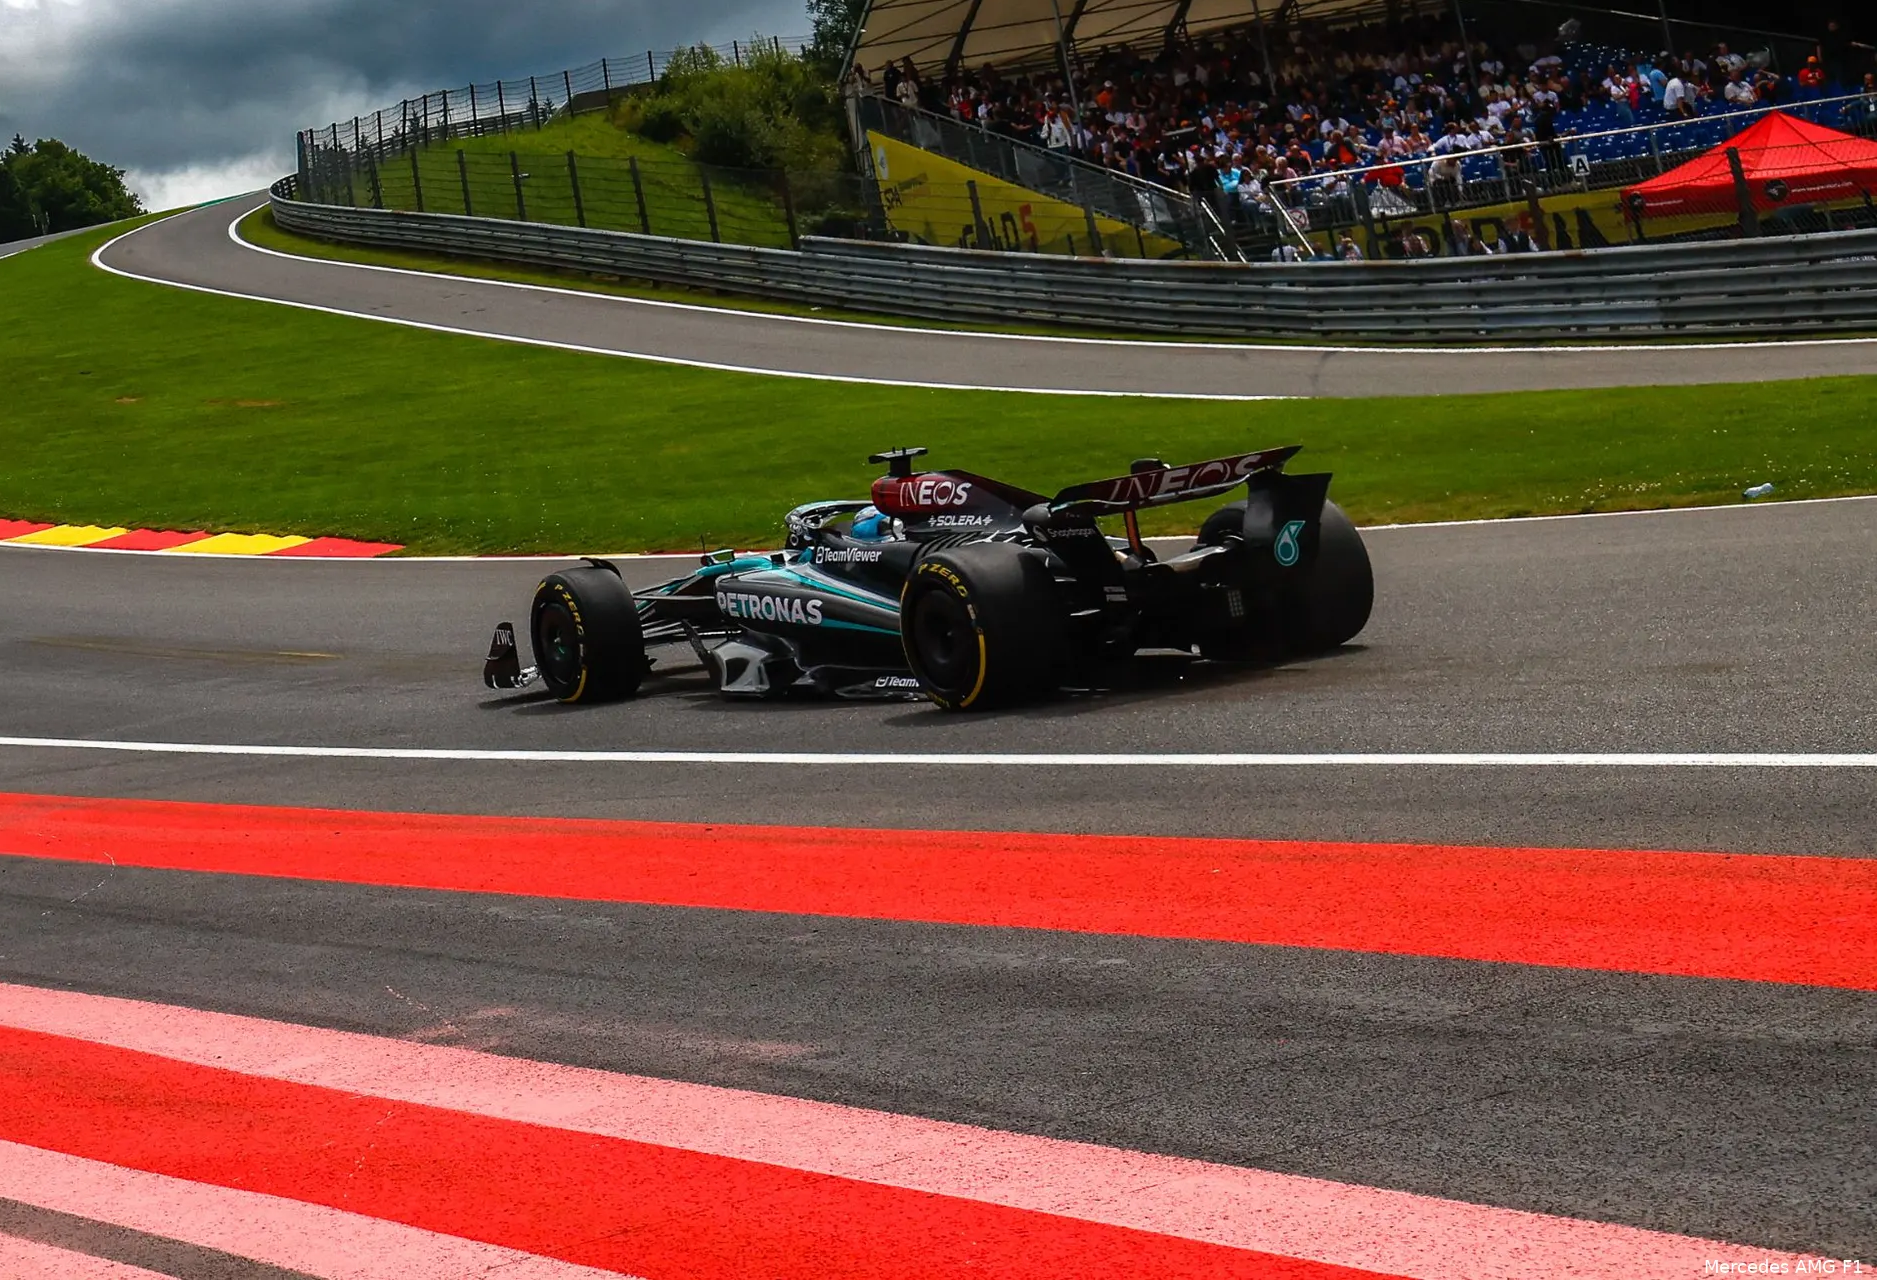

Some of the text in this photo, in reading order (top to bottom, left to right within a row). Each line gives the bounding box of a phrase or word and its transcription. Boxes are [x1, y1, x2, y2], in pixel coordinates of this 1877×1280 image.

[1576, 158, 1589, 173] A
[1105, 455, 1262, 508] INEOS
[900, 480, 972, 506] INEOS
[936, 515, 982, 526] SOLERA
[1046, 528, 1098, 538] Snapdragon
[824, 548, 882, 562] TeamViewer
[918, 563, 969, 598] P ZERO
[562, 592, 585, 636] ZERO
[717, 592, 823, 624] PETRONAS
[496, 630, 514, 646] IWC
